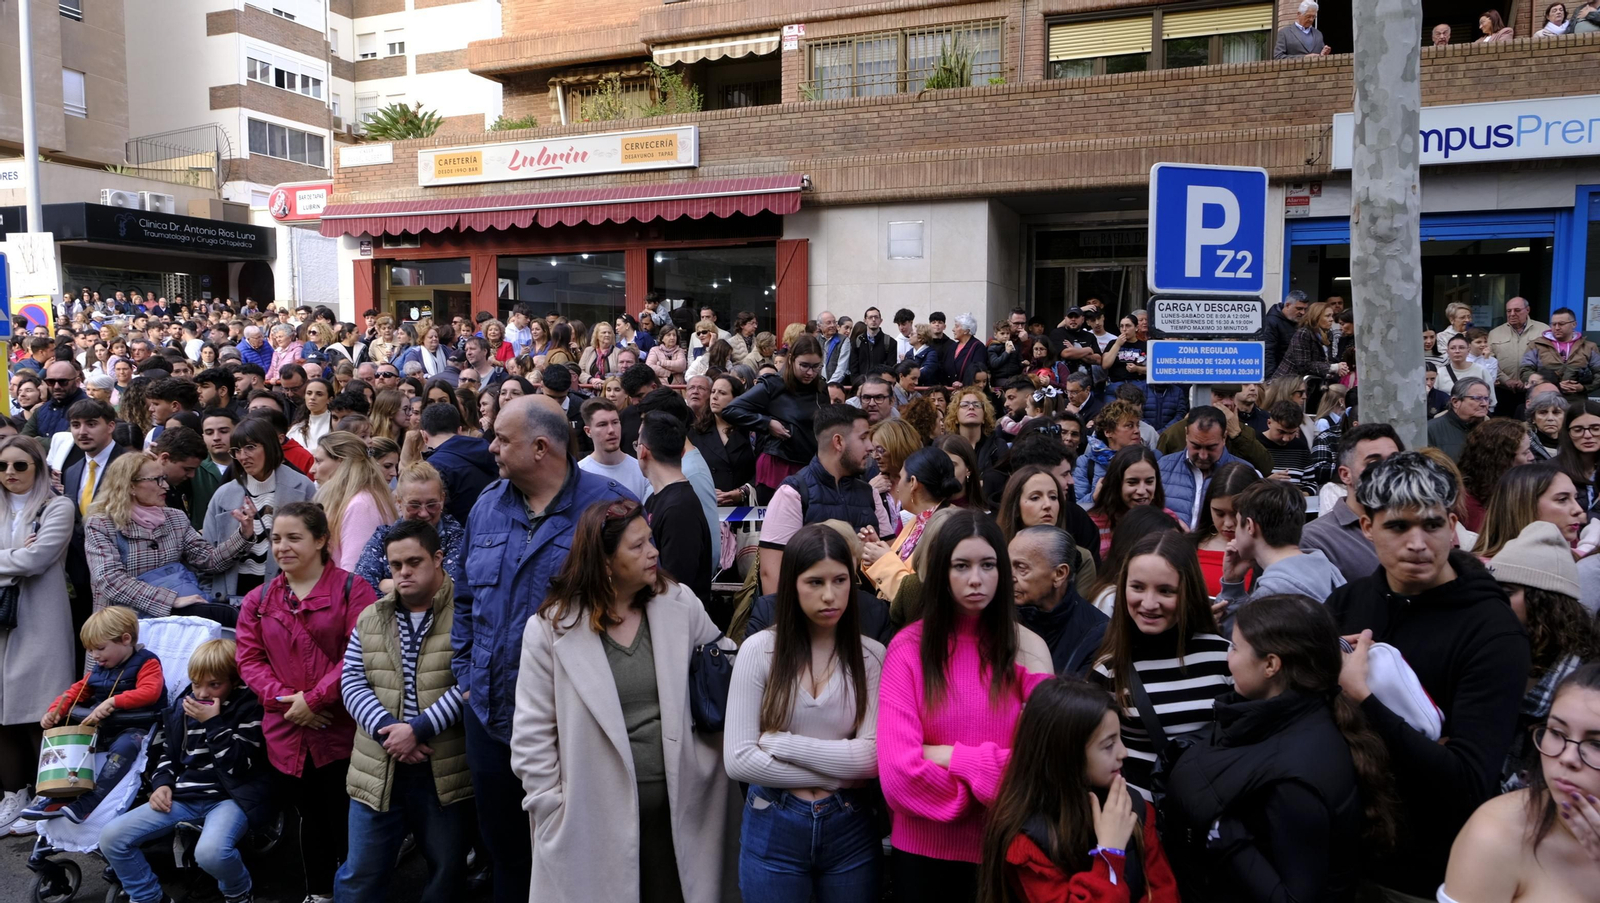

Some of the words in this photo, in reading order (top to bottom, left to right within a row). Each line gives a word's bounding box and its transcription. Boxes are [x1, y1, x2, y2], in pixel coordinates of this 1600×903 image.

[624, 138, 674, 150] CERVECERÍA
[438, 155, 478, 167] CAFETERÍA
[624, 152, 654, 160] DESAYUNOS
[169, 221, 182, 231] Dr.
[184, 224, 217, 236] Antonio
[236, 231, 256, 241] Luna
[1185, 185, 1240, 278] P
[1214, 249, 1253, 278] Z2
[1158, 302, 1193, 312] CARGA
[1195, 303, 1202, 312] Y
[1204, 303, 1258, 313] DESCARGA
[1178, 346, 1199, 354] ZONA
[1200, 346, 1239, 355] REGULADA
[1156, 356, 1204, 365] LUNES-SÁBADO
[1155, 367, 1204, 375] LUNES-VIERNES
